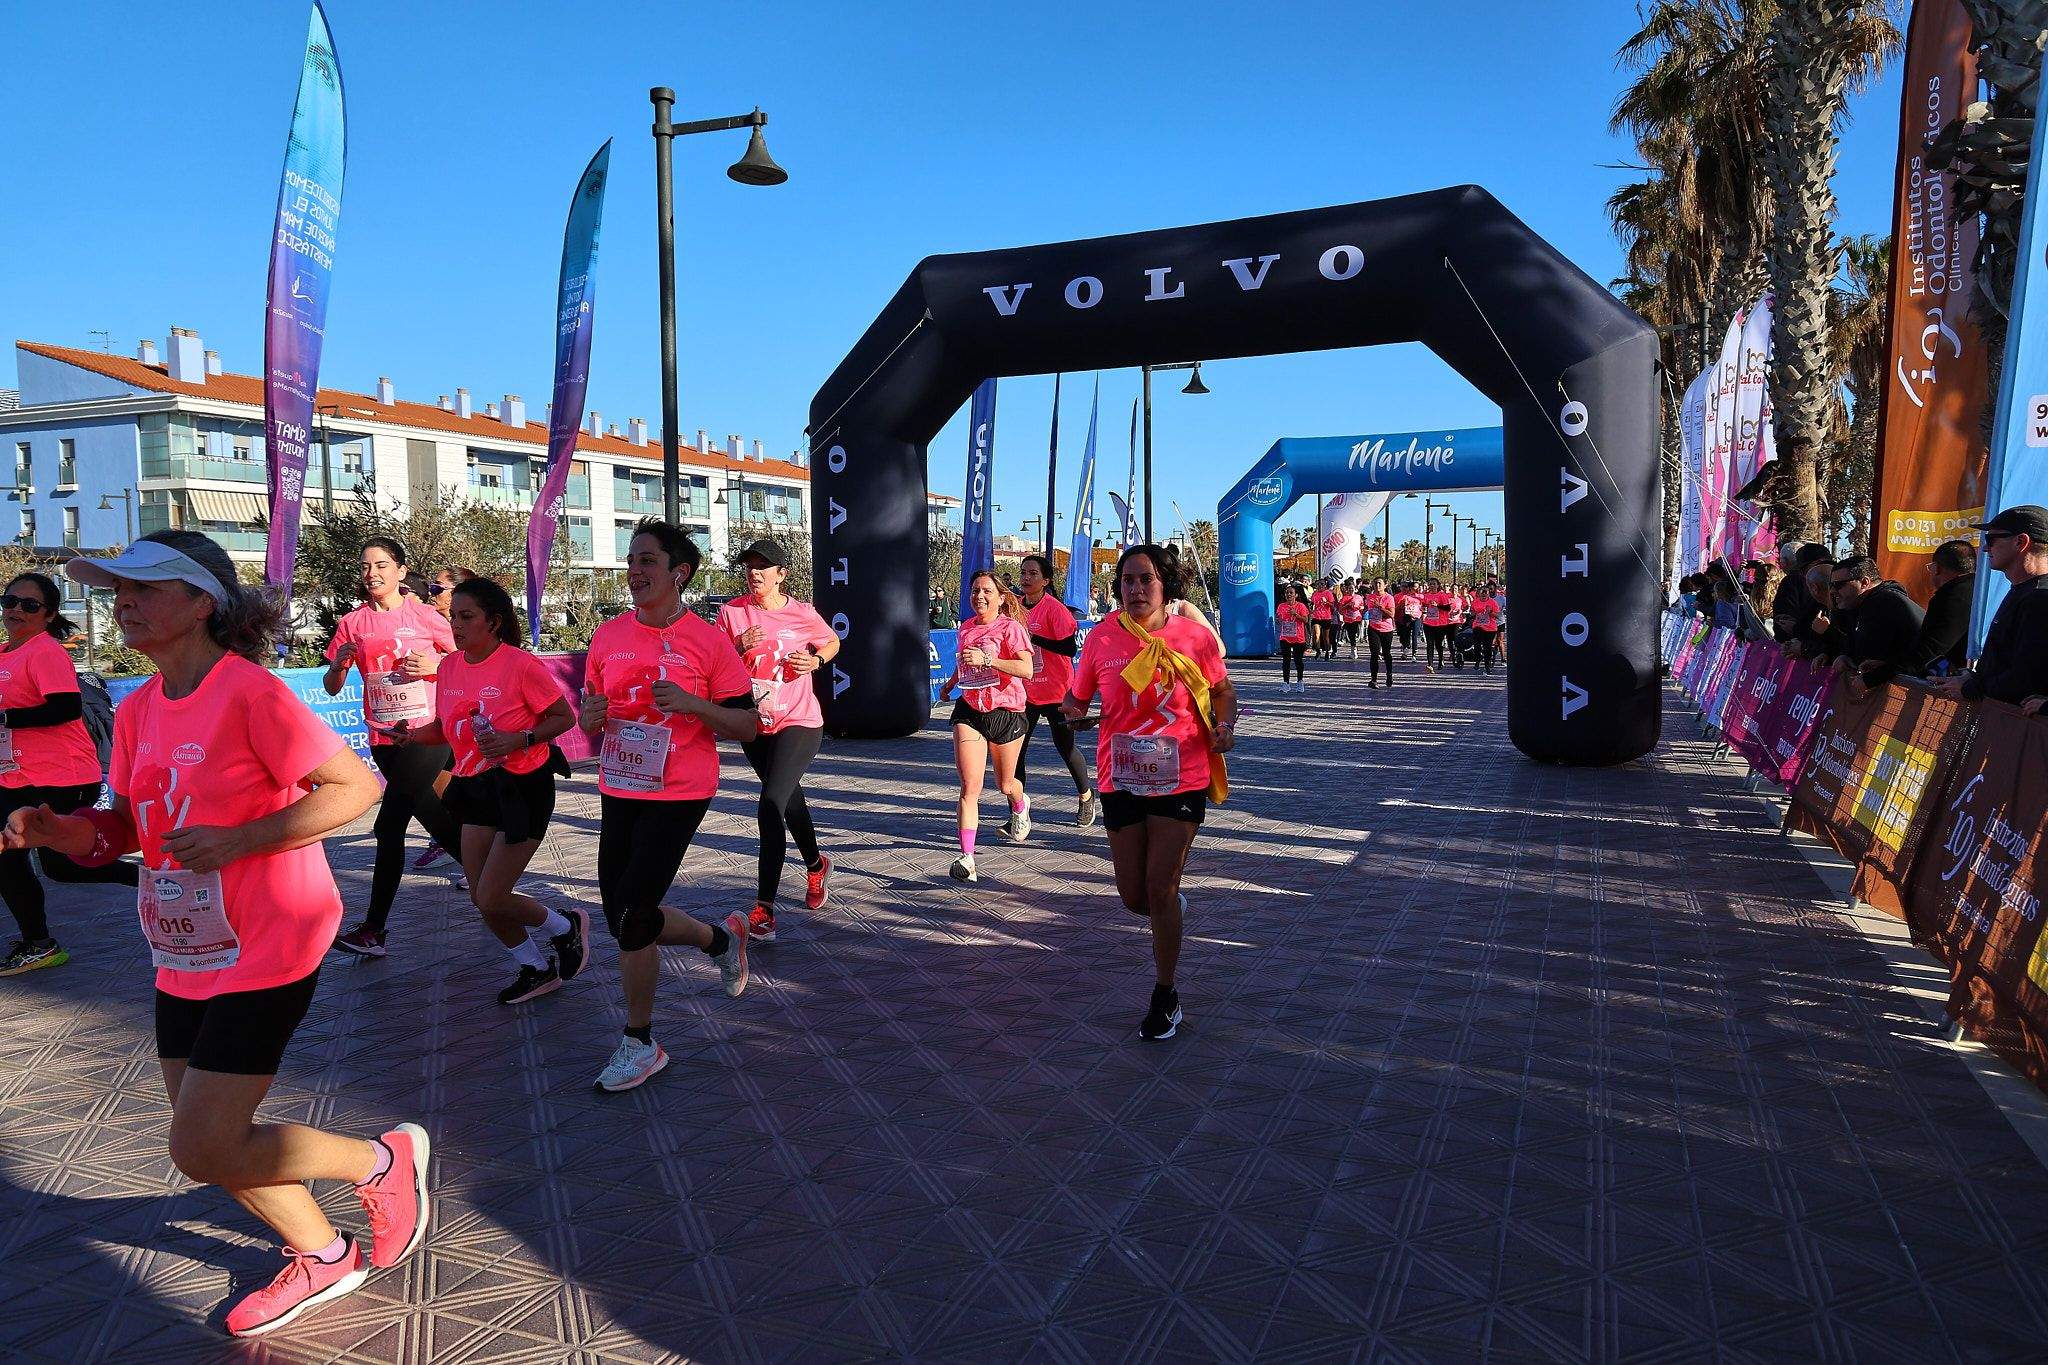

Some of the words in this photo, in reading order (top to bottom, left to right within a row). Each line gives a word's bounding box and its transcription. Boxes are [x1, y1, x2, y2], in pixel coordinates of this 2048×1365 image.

[1924, 75, 1947, 294] Odontolicos
[1907, 154, 1925, 297] Institutos
[983, 244, 1364, 316] VOLVO
[1348, 437, 1454, 484] Marlene
[1250, 484, 1280, 498] Marlene
[828, 444, 851, 700] VOLVO
[1226, 561, 1257, 576] Marlene
[1560, 400, 1588, 720] VOLVO
[386, 693, 407, 701] 016
[1751, 669, 1778, 712] renfe
[1788, 686, 1822, 736] renfe
[618, 752, 643, 765] 016
[1133, 762, 1158, 773] 016
[160, 918, 194, 934] 016
[195, 955, 229, 966] Santander
